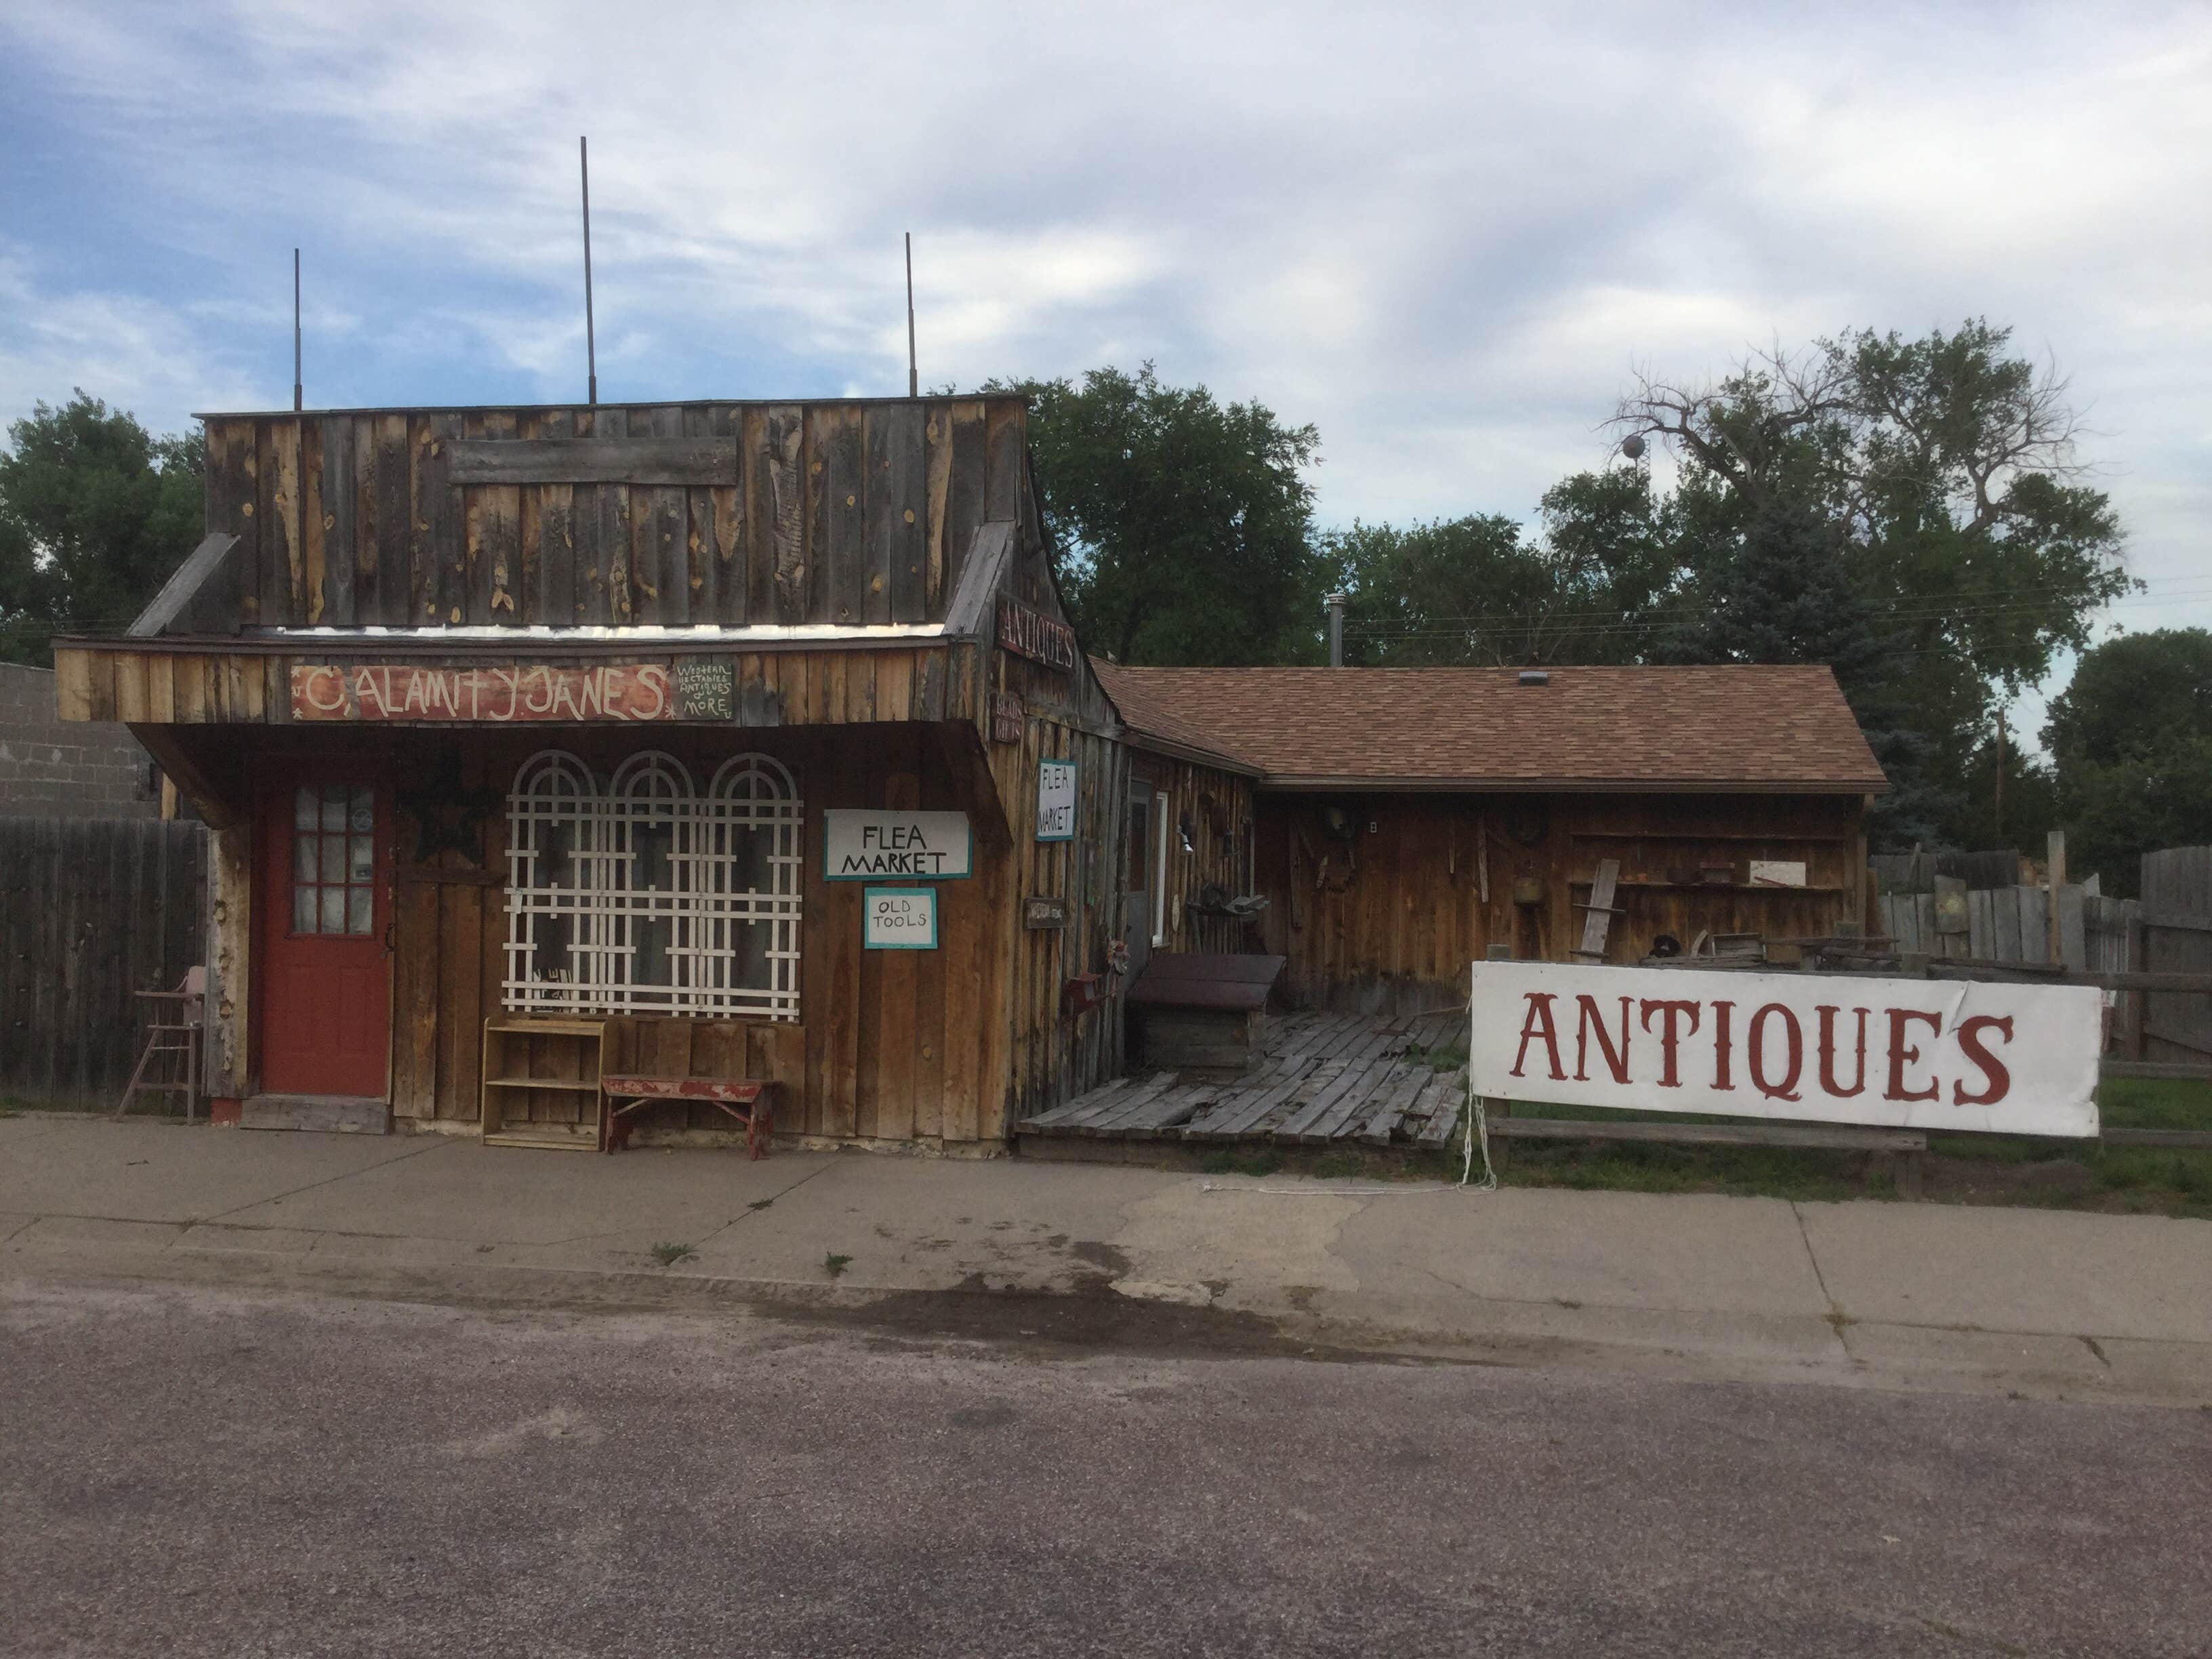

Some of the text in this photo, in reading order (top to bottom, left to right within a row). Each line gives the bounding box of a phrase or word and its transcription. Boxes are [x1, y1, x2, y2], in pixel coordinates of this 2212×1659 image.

[1002, 600, 1073, 668] ANTIQUES
[306, 665, 665, 721] CALAMITY JANES
[684, 698, 727, 716] MORE
[1042, 766, 1069, 790] FLEA
[1038, 805, 1071, 833] MARKET
[863, 825, 927, 850] FLEA
[841, 852, 947, 874] MARKET
[878, 900, 911, 914] OLD
[873, 914, 926, 928] TOOLS
[1509, 991, 2013, 1107] ANTIQUES
